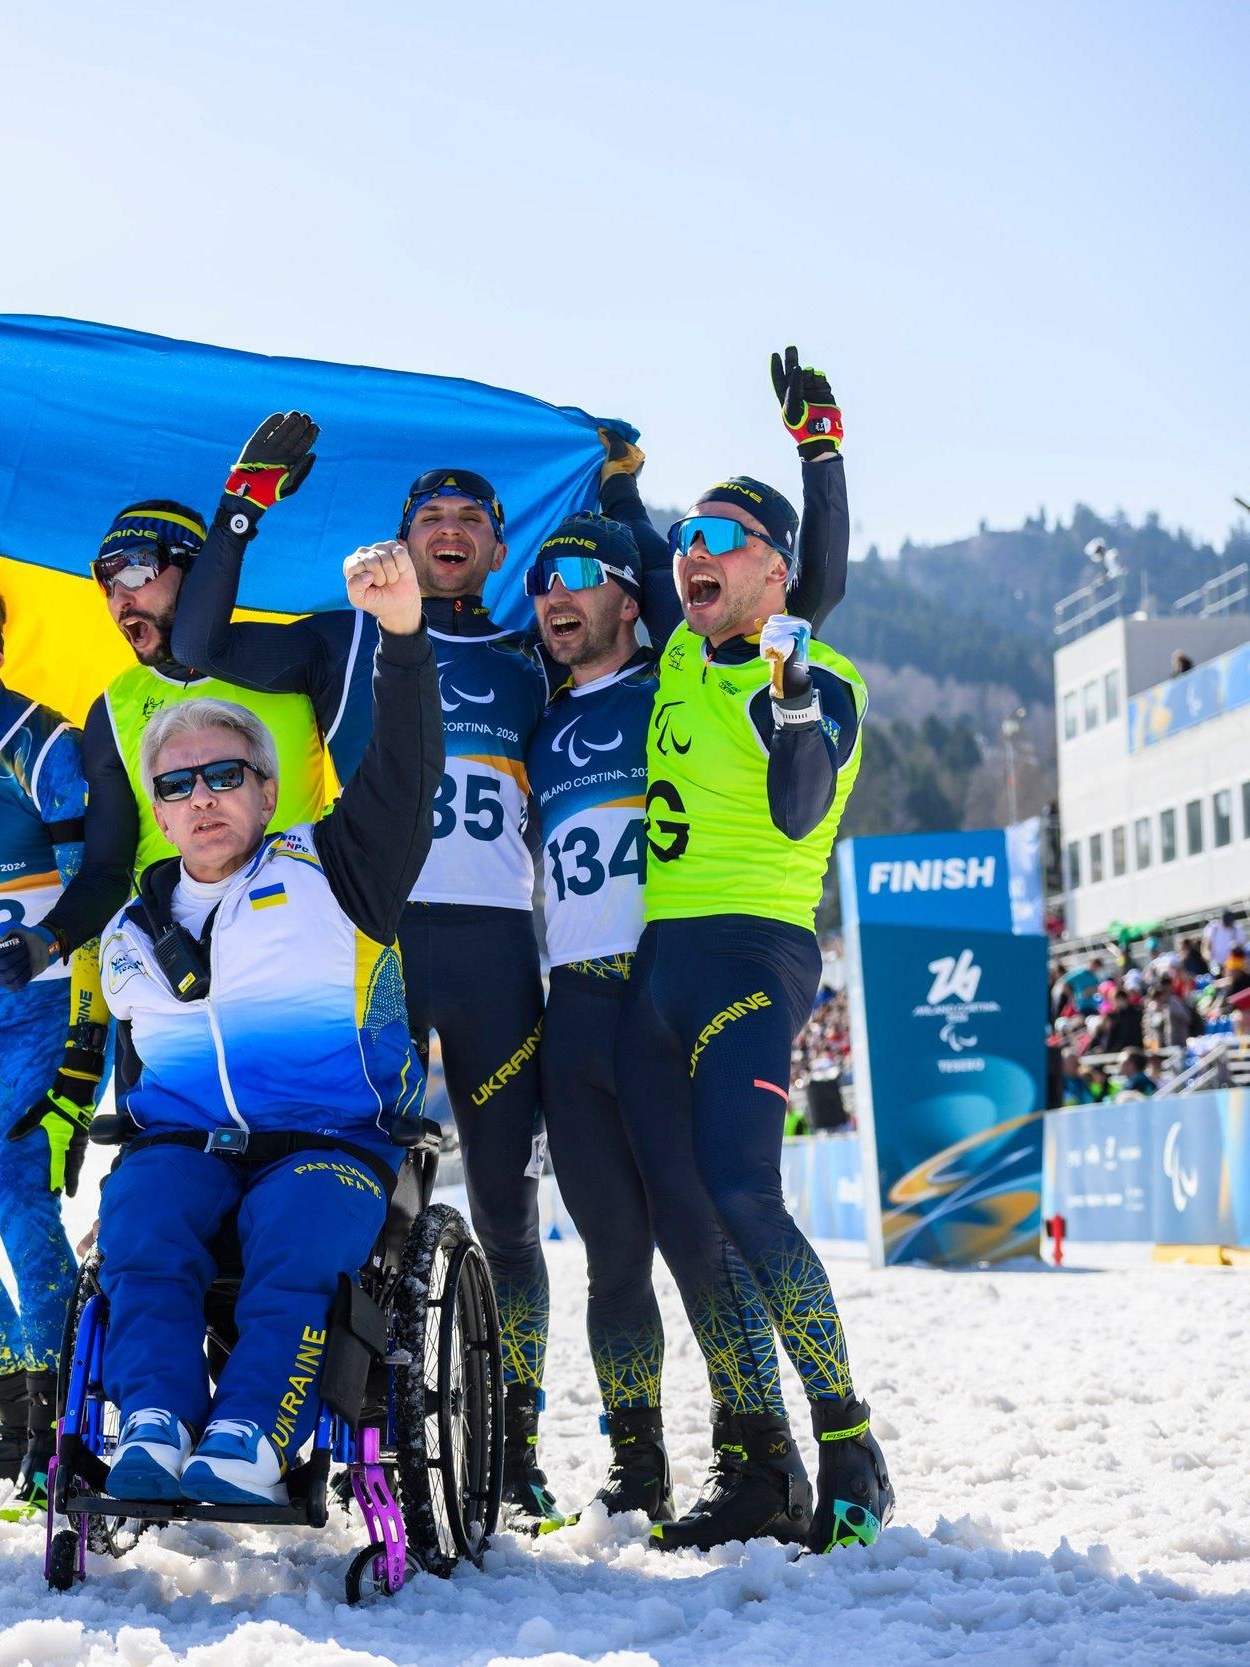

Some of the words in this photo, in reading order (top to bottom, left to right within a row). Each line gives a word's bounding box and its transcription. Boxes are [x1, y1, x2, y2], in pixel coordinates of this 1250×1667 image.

[101, 529, 158, 545] RAINE
[540, 536, 597, 551] RAINE
[496, 727, 518, 743] 2026
[540, 780, 572, 807] MILANO
[573, 769, 628, 788] CORTINA
[631, 767, 648, 778] 20
[432, 772, 504, 842] 35
[0, 861, 27, 872] 2026
[548, 818, 648, 902] 134
[868, 856, 996, 895] FINISH
[690, 991, 772, 1078] UKRAINE
[271, 1325, 327, 1448] UKRAINE
